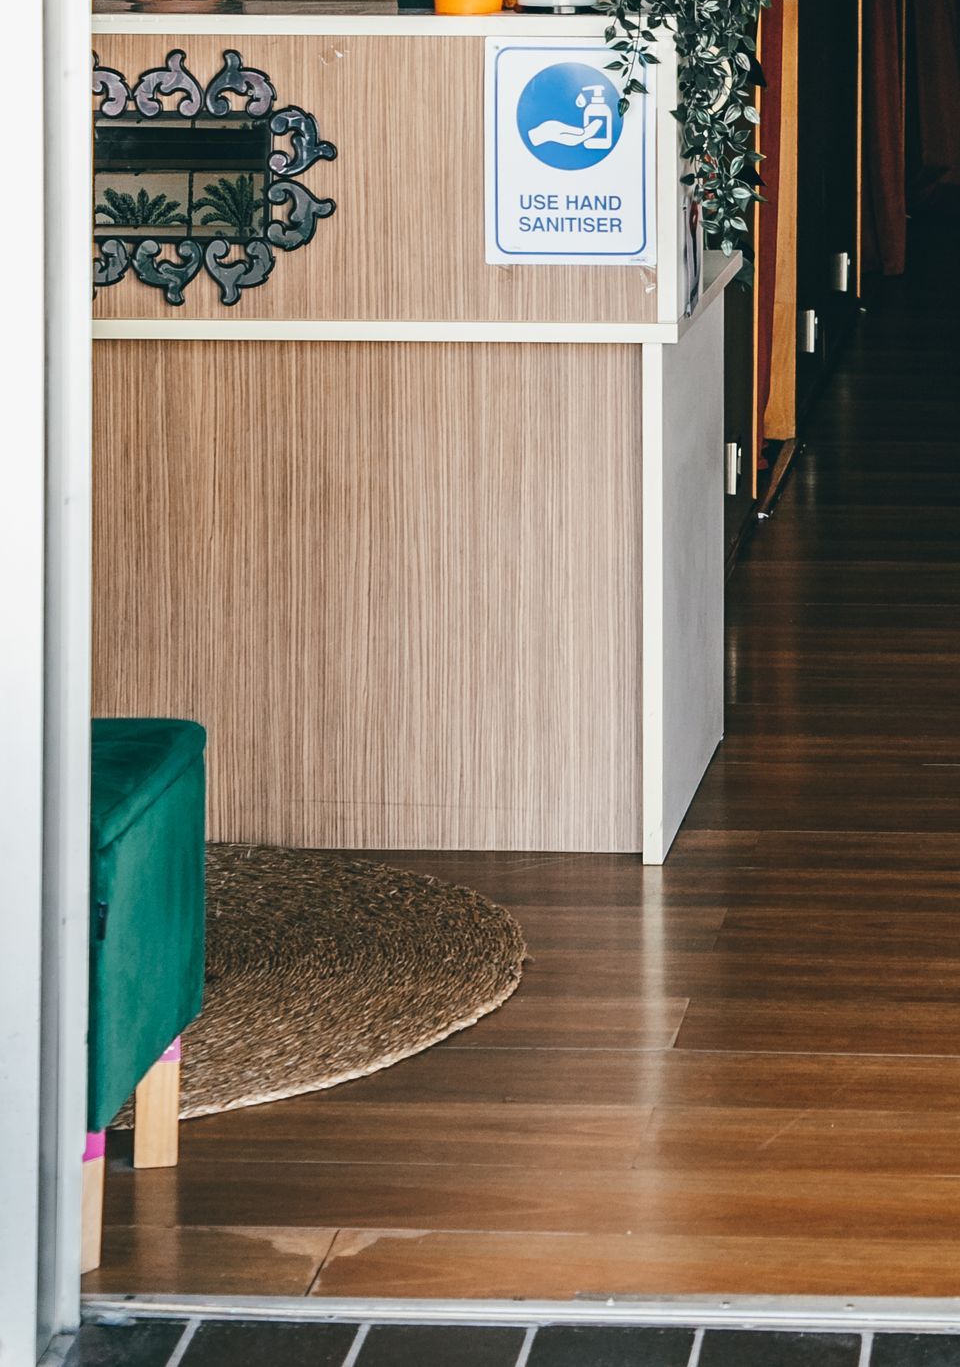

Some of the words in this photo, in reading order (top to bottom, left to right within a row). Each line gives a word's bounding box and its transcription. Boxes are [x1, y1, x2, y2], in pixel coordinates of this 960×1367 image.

[520, 194, 559, 210] USE
[566, 195, 622, 211] HAND
[519, 216, 622, 233] SANITISER
